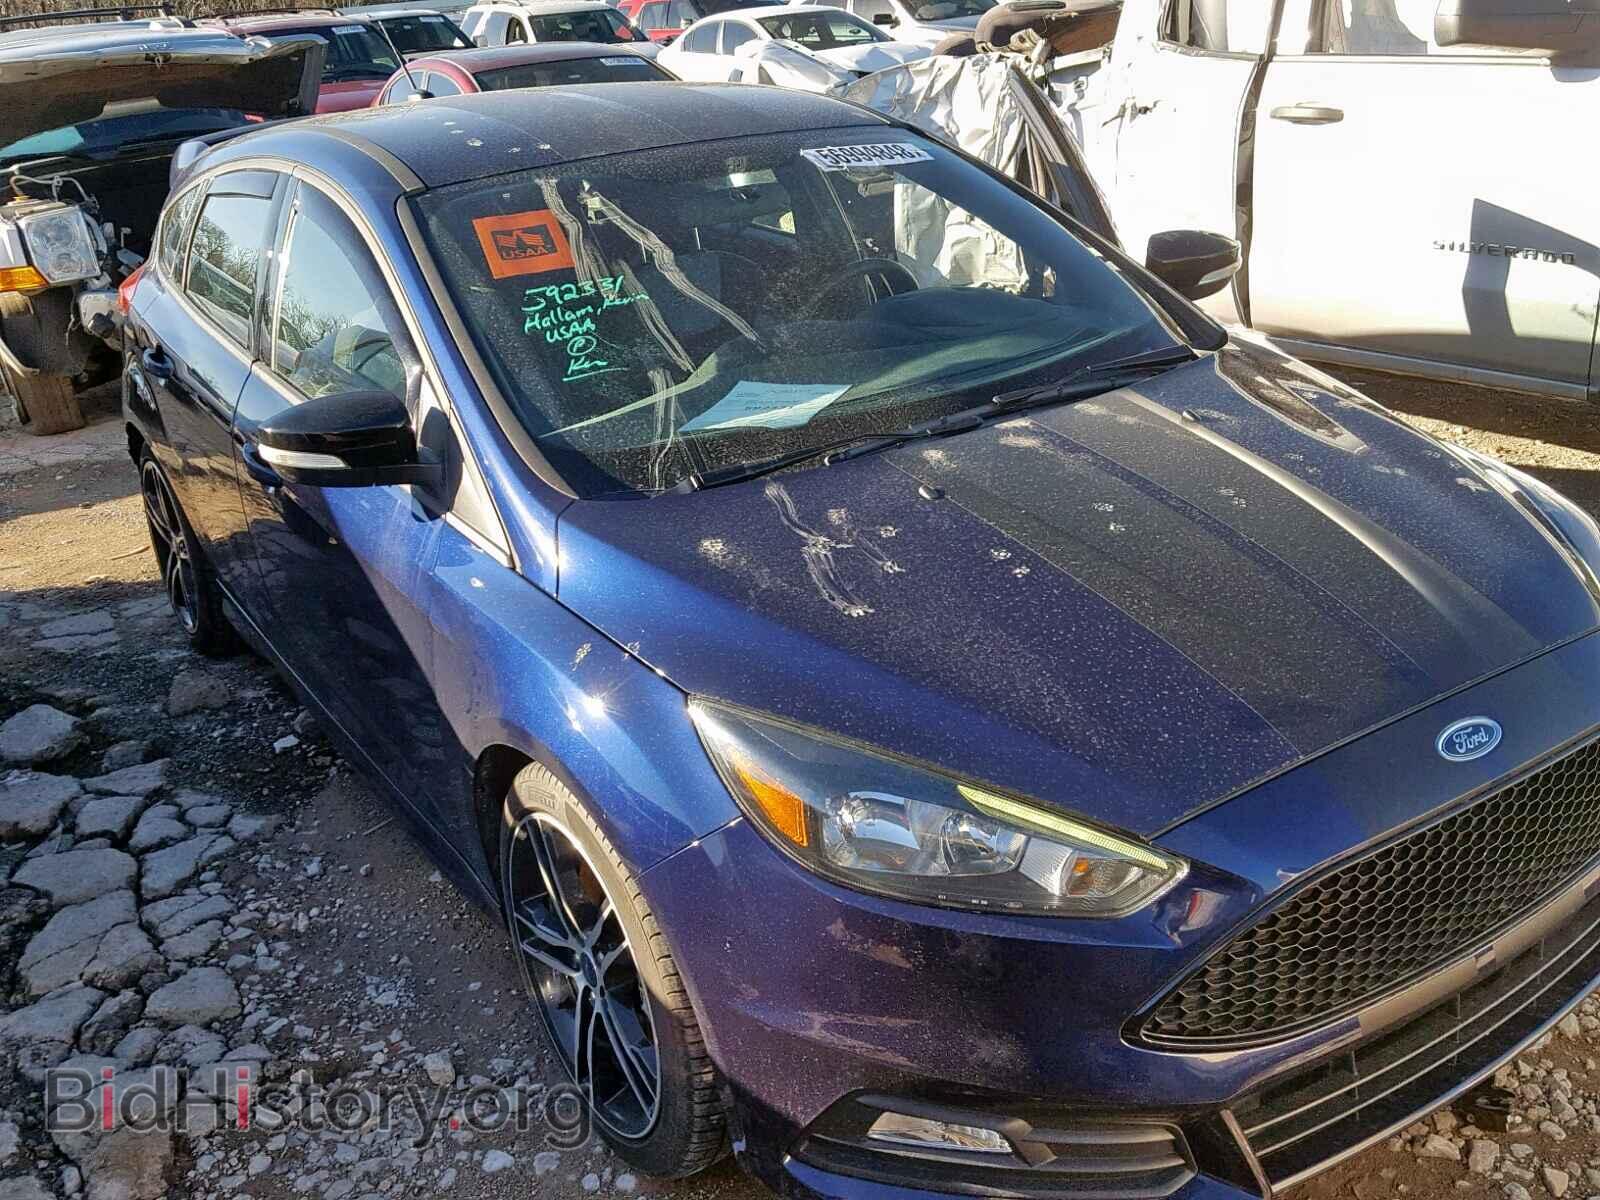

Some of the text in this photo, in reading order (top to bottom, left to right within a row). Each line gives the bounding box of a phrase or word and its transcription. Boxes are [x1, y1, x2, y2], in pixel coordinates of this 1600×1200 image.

[502, 245, 549, 260] USAA
[1432, 240, 1576, 265] SILVERADO
[1452, 726, 1489, 753] Ford
